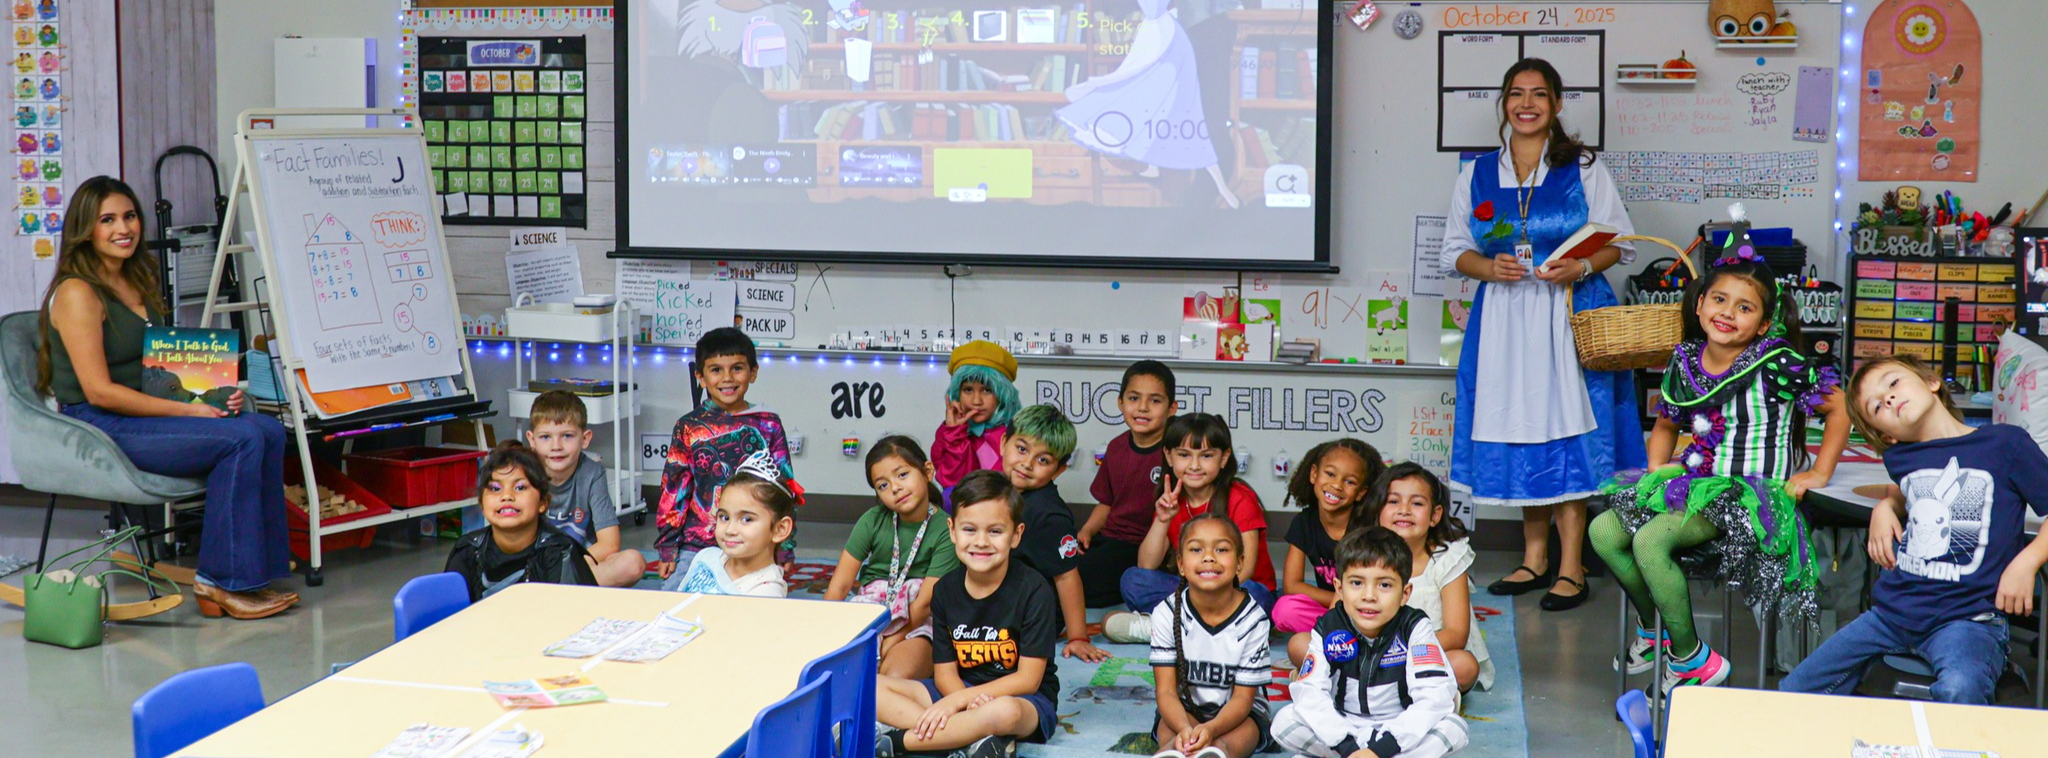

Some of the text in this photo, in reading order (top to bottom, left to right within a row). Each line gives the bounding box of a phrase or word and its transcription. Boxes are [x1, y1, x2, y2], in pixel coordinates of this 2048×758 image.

[802, 9, 819, 25] 2.
[888, 13, 904, 30] 3.
[951, 10, 970, 27] 4.
[1077, 12, 1132, 33] 5. Pick
[1444, 4, 1531, 28] October
[1575, 7, 1616, 24] 2025
[480, 48, 510, 58] OCTOBER
[1741, 76, 1785, 85] lunch with
[1750, 83, 1780, 91] teacher
[1752, 104, 1776, 115] Ryan
[1749, 116, 1777, 131] Jayla
[544, 128, 550, 137] 10
[274, 144, 384, 173] Fact Families!
[453, 153, 460, 161] 13
[497, 153, 504, 162] 15
[522, 153, 529, 162] 16
[547, 154, 554, 163] 17
[569, 154, 576, 162] 18
[391, 156, 404, 183] J
[335, 175, 342, 184] of
[345, 174, 372, 184] related
[454, 178, 463, 187] 20
[498, 178, 507, 187] 22
[521, 178, 531, 187] 23
[544, 179, 552, 188] 24
[322, 186, 349, 197] addition
[352, 186, 366, 196] and
[326, 217, 335, 226] 15
[345, 231, 352, 241] 8
[523, 232, 557, 245] SCIENCE
[1855, 228, 1936, 257] Blessed
[400, 253, 410, 261] 15
[396, 265, 424, 278] 7 8
[754, 261, 796, 274] SPECIALS
[1254, 278, 1268, 291] Ee
[1380, 280, 1397, 292] Aa
[350, 287, 358, 297] 8
[415, 288, 423, 297] 7
[746, 288, 784, 302] SCIENCE
[1803, 293, 1835, 308] TABLE
[398, 311, 410, 324] 15
[746, 318, 786, 334] PACK UP
[334, 338, 354, 350] sets
[357, 336, 367, 347] of
[369, 334, 392, 346] facts
[427, 336, 436, 349] 8
[884, 330, 901, 347] help
[904, 329, 910, 339] 4
[921, 330, 927, 339] 5
[938, 330, 944, 339] 6
[966, 331, 972, 339] 8
[983, 331, 990, 340] 9
[1014, 332, 1023, 341] 10
[1065, 334, 1073, 343] 13
[1082, 334, 1091, 343] 14
[1100, 334, 1108, 344] 15
[1121, 335, 1130, 344] 16
[1140, 335, 1148, 345] 17
[1157, 335, 1165, 345] 18
[152, 340, 230, 353] When I Talk to God,
[1024, 337, 1048, 353] jump
[158, 351, 223, 364] I Talk About You
[350, 351, 361, 361] the
[831, 380, 886, 420] are
[1228, 386, 1386, 433] FILLERS
[1421, 406, 1437, 419] Sit
[1421, 423, 1443, 436] Face
[1422, 437, 1450, 454] Only
[1422, 453, 1450, 467] Level
[953, 624, 980, 640] Fall
[1328, 643, 1355, 652] NASA
